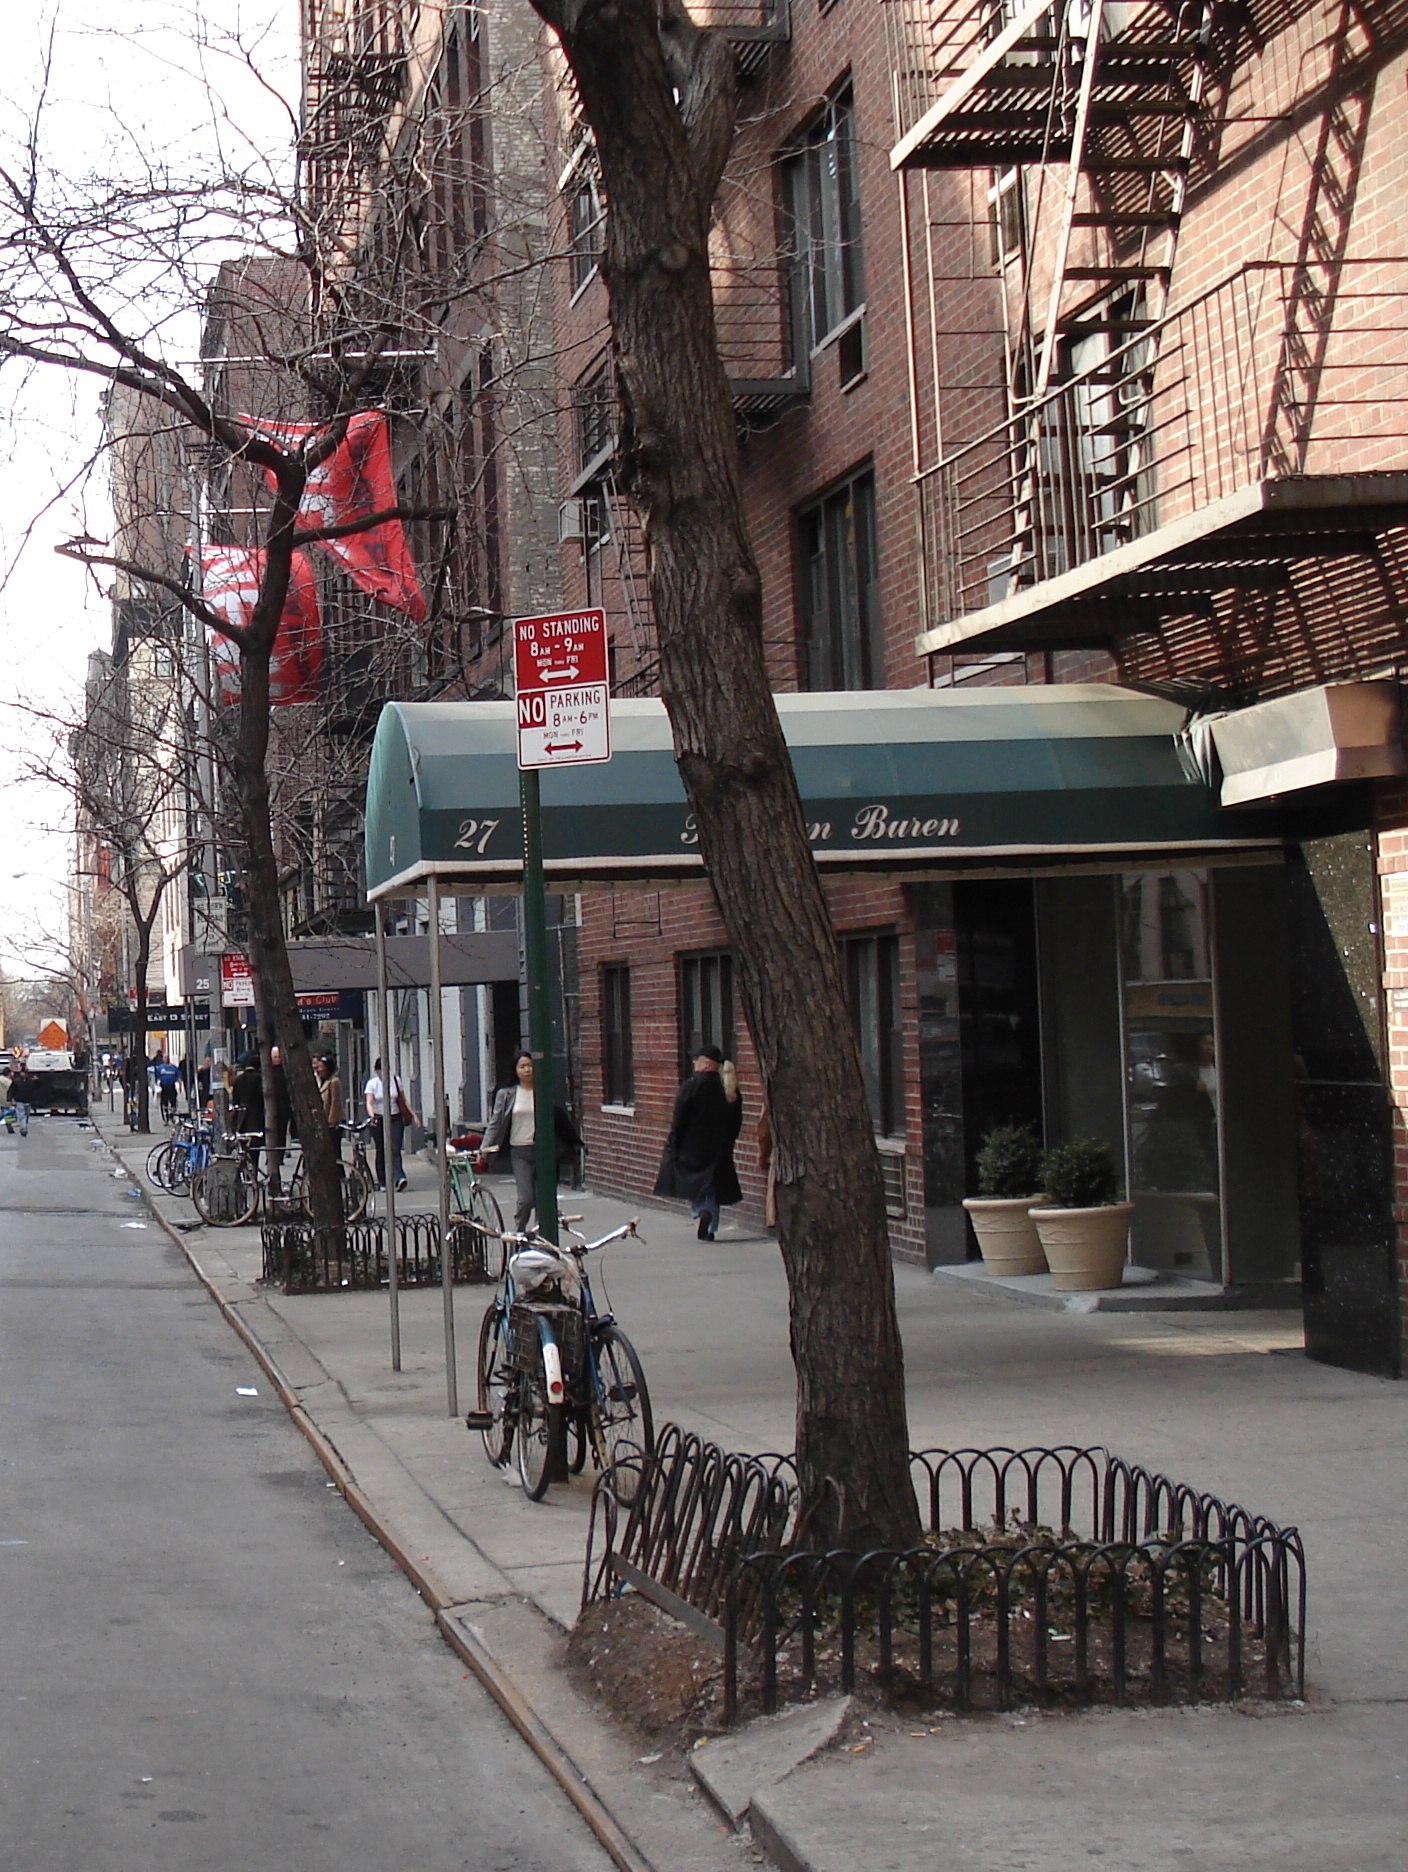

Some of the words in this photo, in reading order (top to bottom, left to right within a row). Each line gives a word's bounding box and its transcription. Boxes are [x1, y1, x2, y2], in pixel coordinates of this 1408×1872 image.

[519, 625, 535, 641] NO
[543, 616, 599, 638] STANDING
[530, 641, 551, 657] 8AM
[564, 637, 584, 652] 9AM
[536, 658, 552, 667] MON
[566, 655, 579, 665] FRI
[519, 697, 545, 724] NO
[550, 690, 601, 709] PARKING
[543, 730, 559, 739] MON
[571, 728, 584, 737] FRI
[851, 804, 961, 840] Buren
[454, 819, 500, 854] 27
[196, 979, 209, 990] 25
[315, 996, 337, 1005] Club
